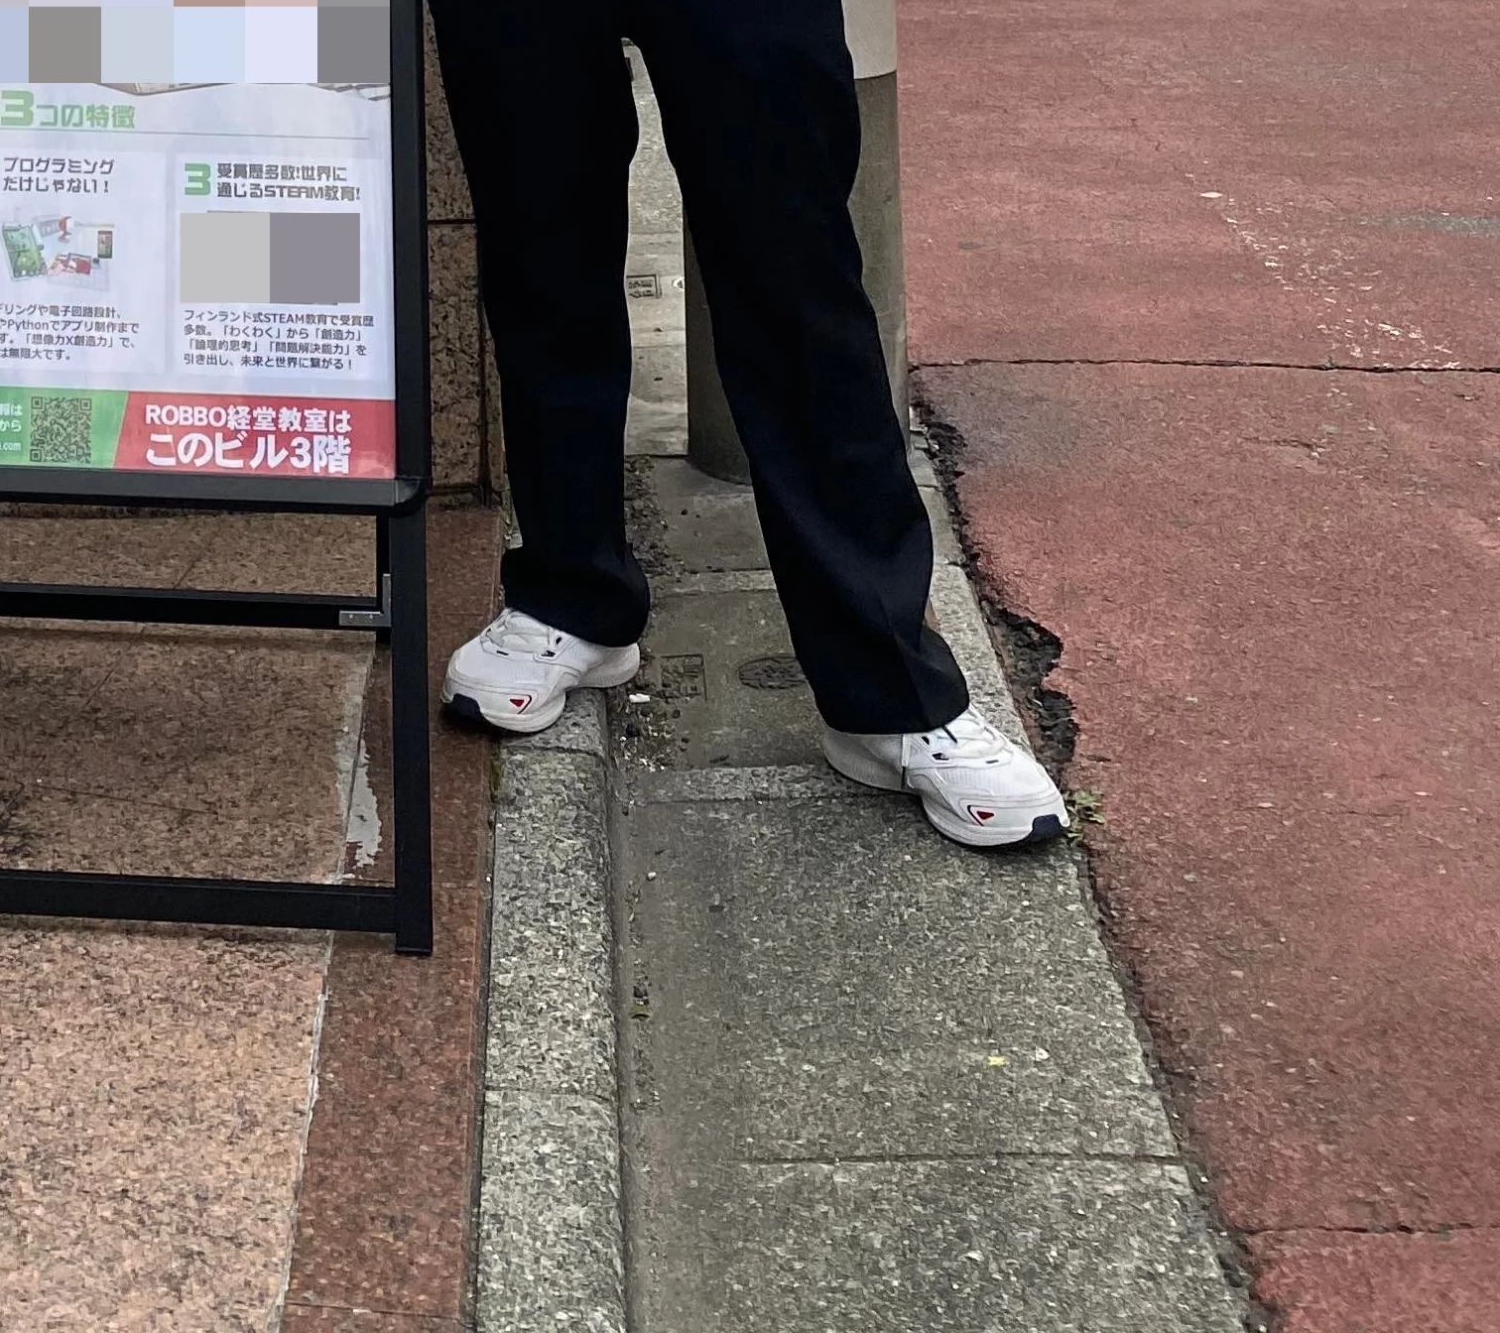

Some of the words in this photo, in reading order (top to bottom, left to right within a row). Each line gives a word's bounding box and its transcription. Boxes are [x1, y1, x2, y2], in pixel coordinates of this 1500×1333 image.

[4, 158, 115, 176] プログラミング
[184, 163, 211, 196] 3
[145, 404, 352, 433] ROBBO経堂教室は
[146, 431, 352, 474] このビル3階
